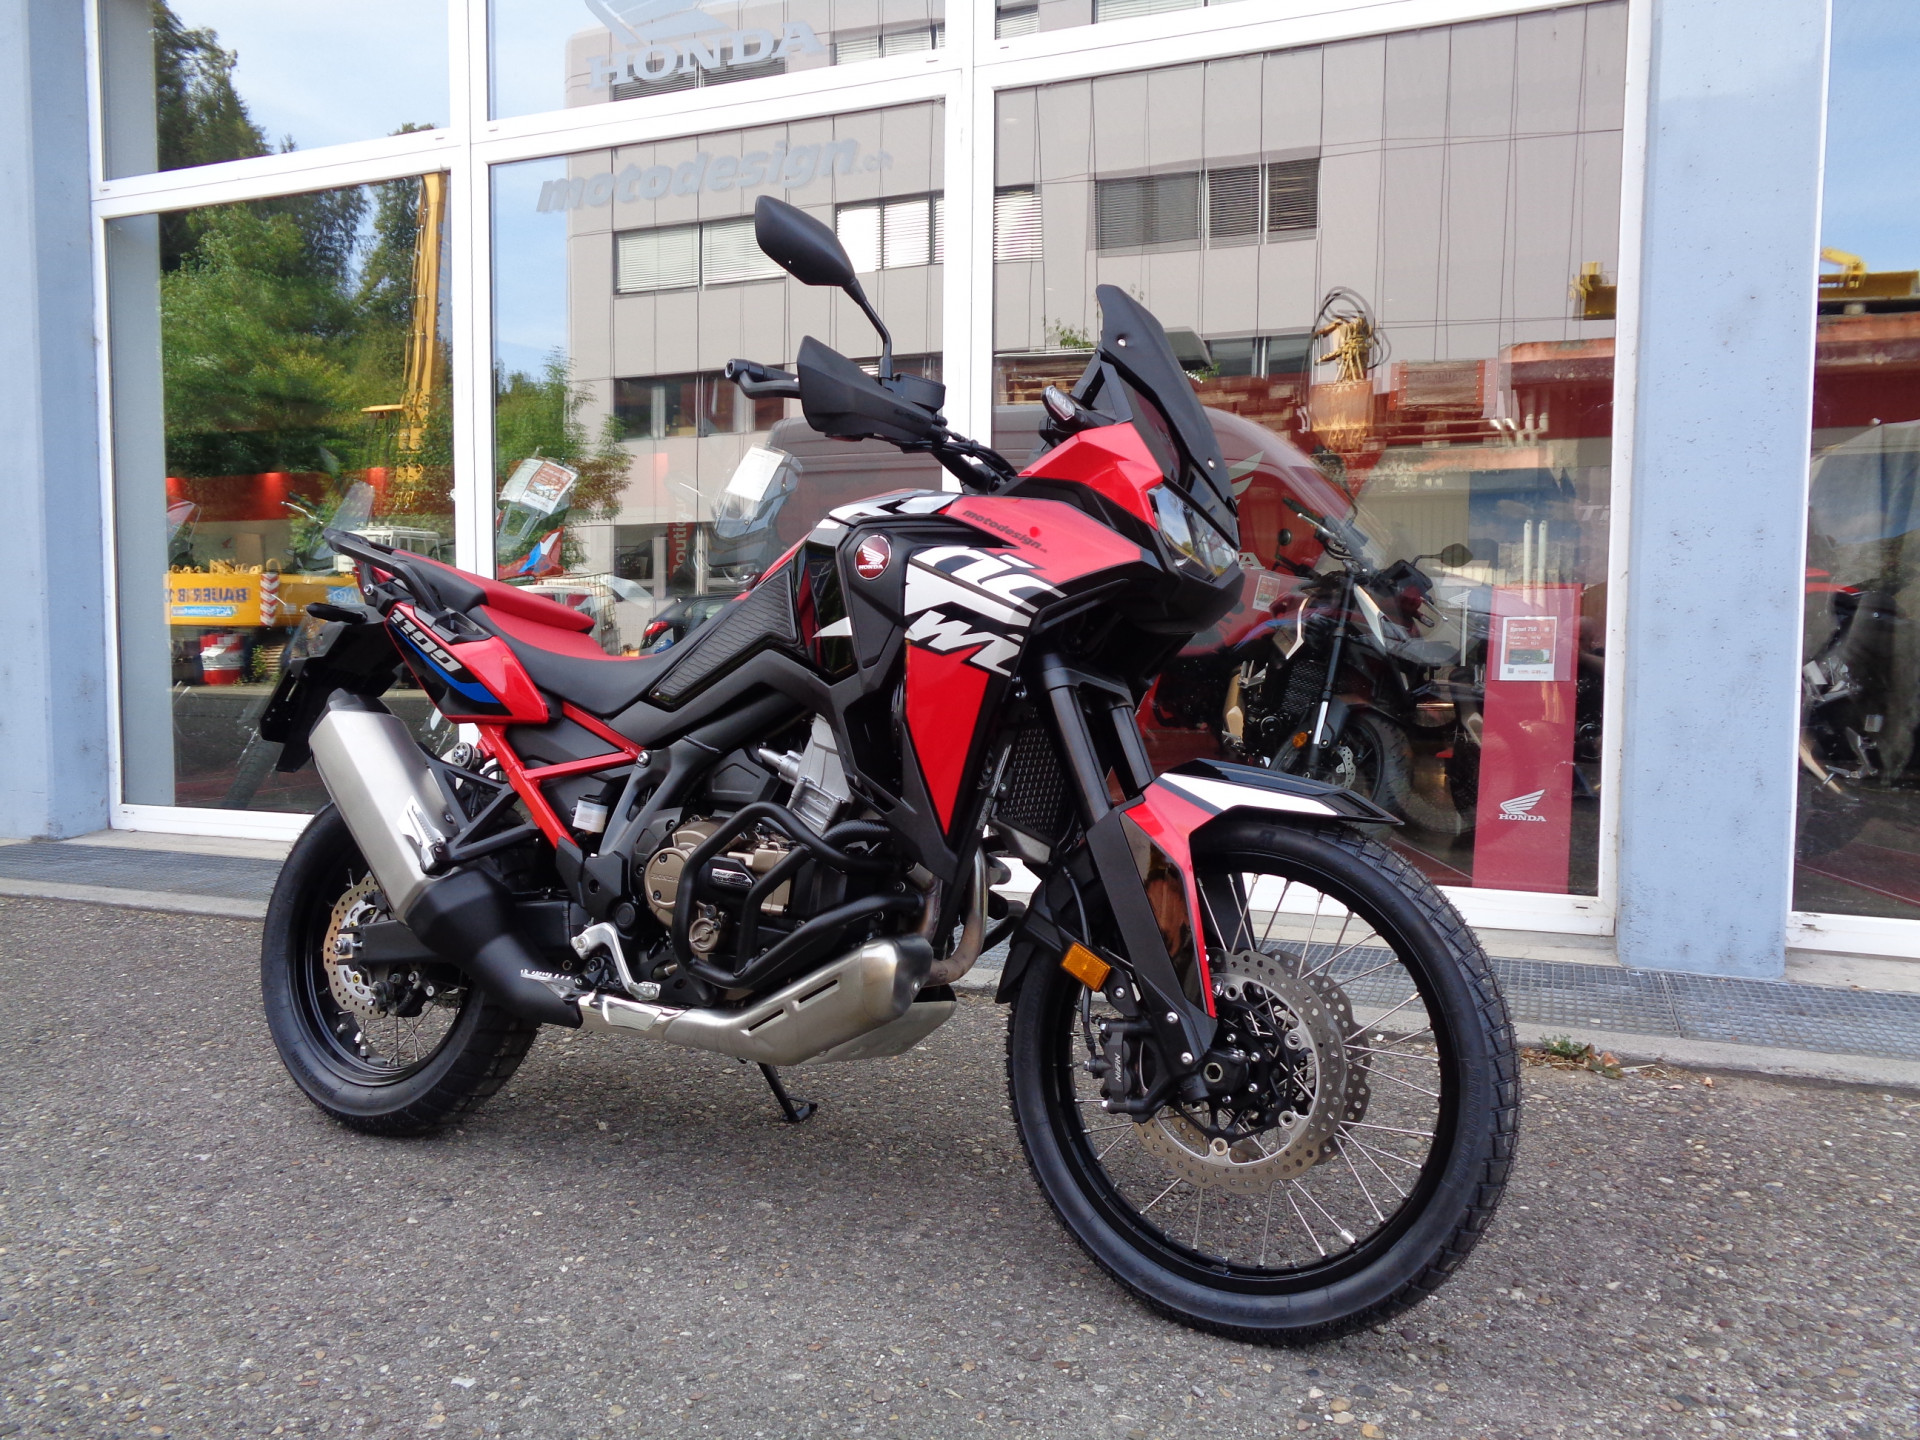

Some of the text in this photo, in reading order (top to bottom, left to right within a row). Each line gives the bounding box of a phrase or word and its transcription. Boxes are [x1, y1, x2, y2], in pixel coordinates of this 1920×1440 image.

[586, 20, 826, 90] HONDA
[390, 609, 463, 672] 1100
[1498, 813, 1547, 822] HONDA
